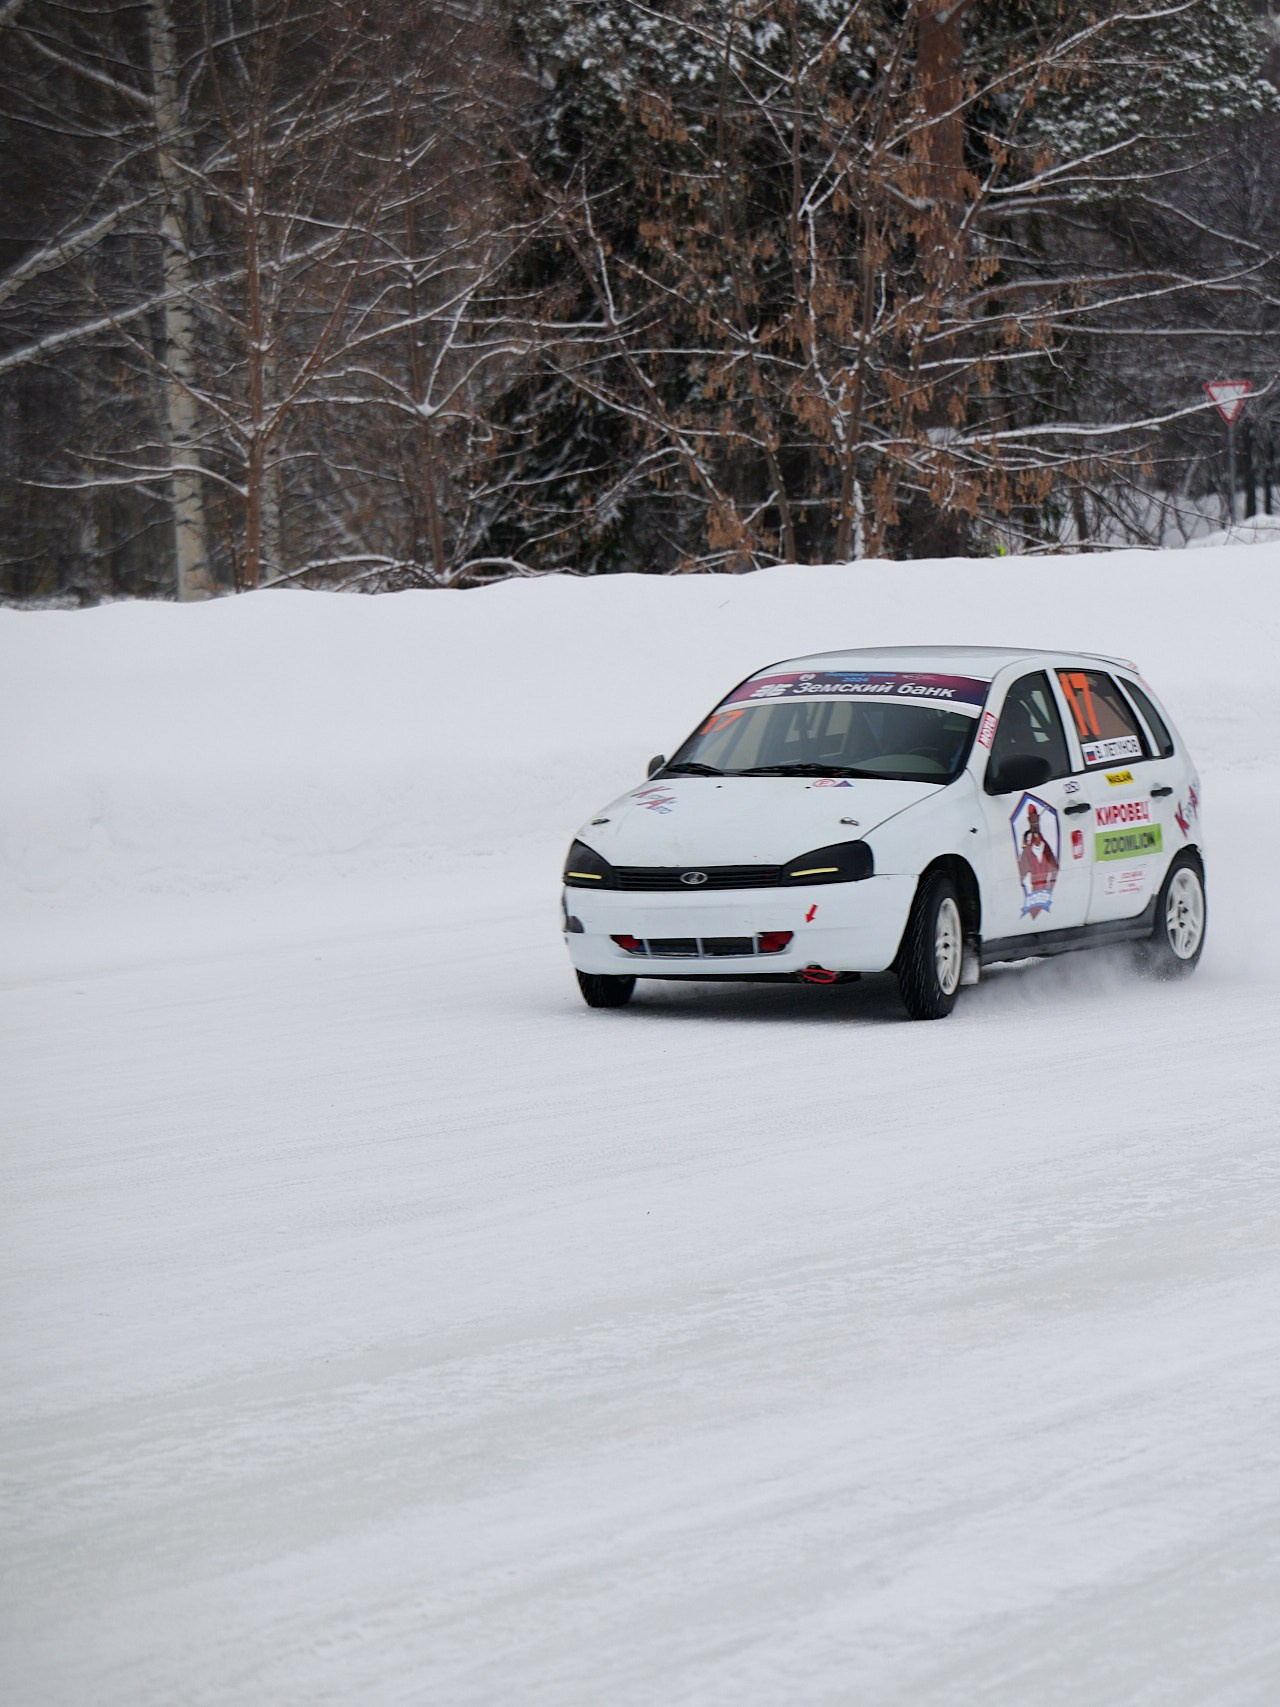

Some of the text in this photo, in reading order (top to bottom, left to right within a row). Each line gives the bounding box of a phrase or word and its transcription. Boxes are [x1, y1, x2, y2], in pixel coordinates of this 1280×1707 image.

[792, 681, 958, 698] Земский банк
[1058, 672, 1101, 737] 17
[700, 709, 748, 735] 17
[1096, 800, 1151, 827] КИРОВЕЦ
[1104, 831, 1157, 856] ZOOMLION
